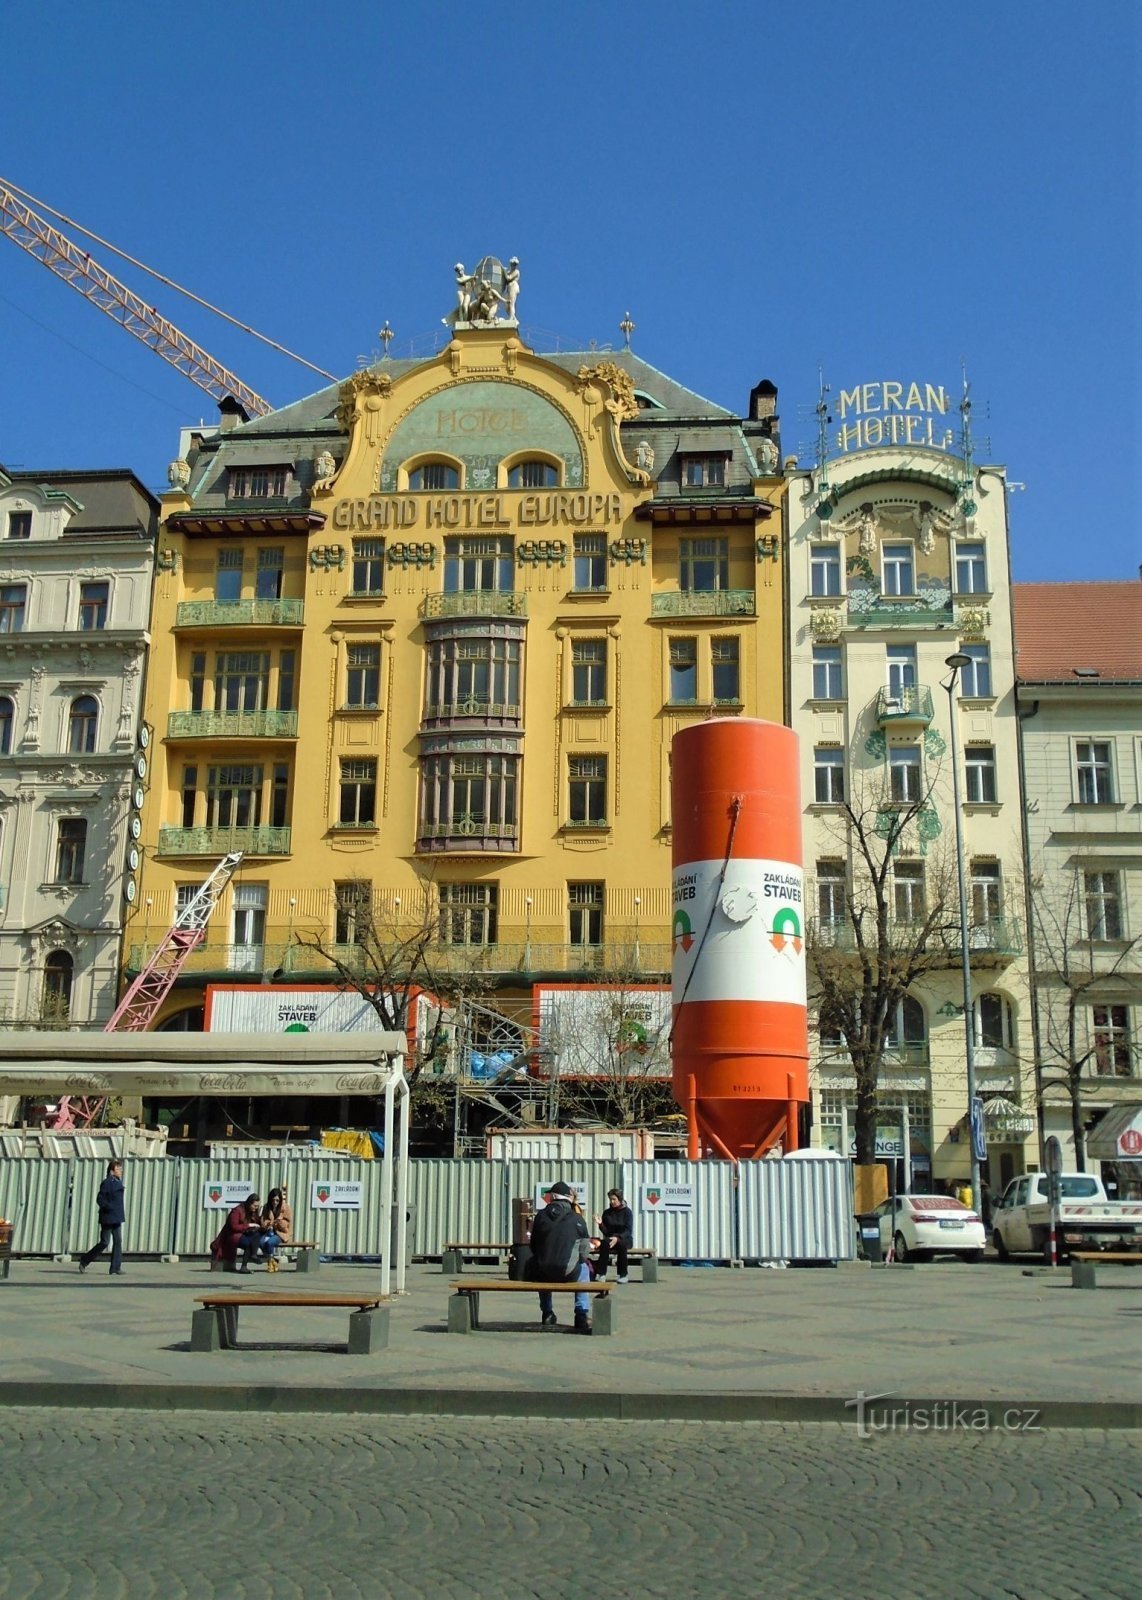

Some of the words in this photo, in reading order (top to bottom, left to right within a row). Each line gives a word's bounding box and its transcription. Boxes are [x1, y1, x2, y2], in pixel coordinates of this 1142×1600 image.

[839, 381, 947, 420] MERAN
[841, 415, 946, 452] HOTEL
[335, 497, 420, 529] GRAND
[428, 494, 511, 526] HOTEL
[520, 491, 625, 525] EUROPA
[672, 886, 696, 903] TAVEB
[763, 884, 801, 903] STAVEB
[278, 1012, 317, 1022] STAVEB
